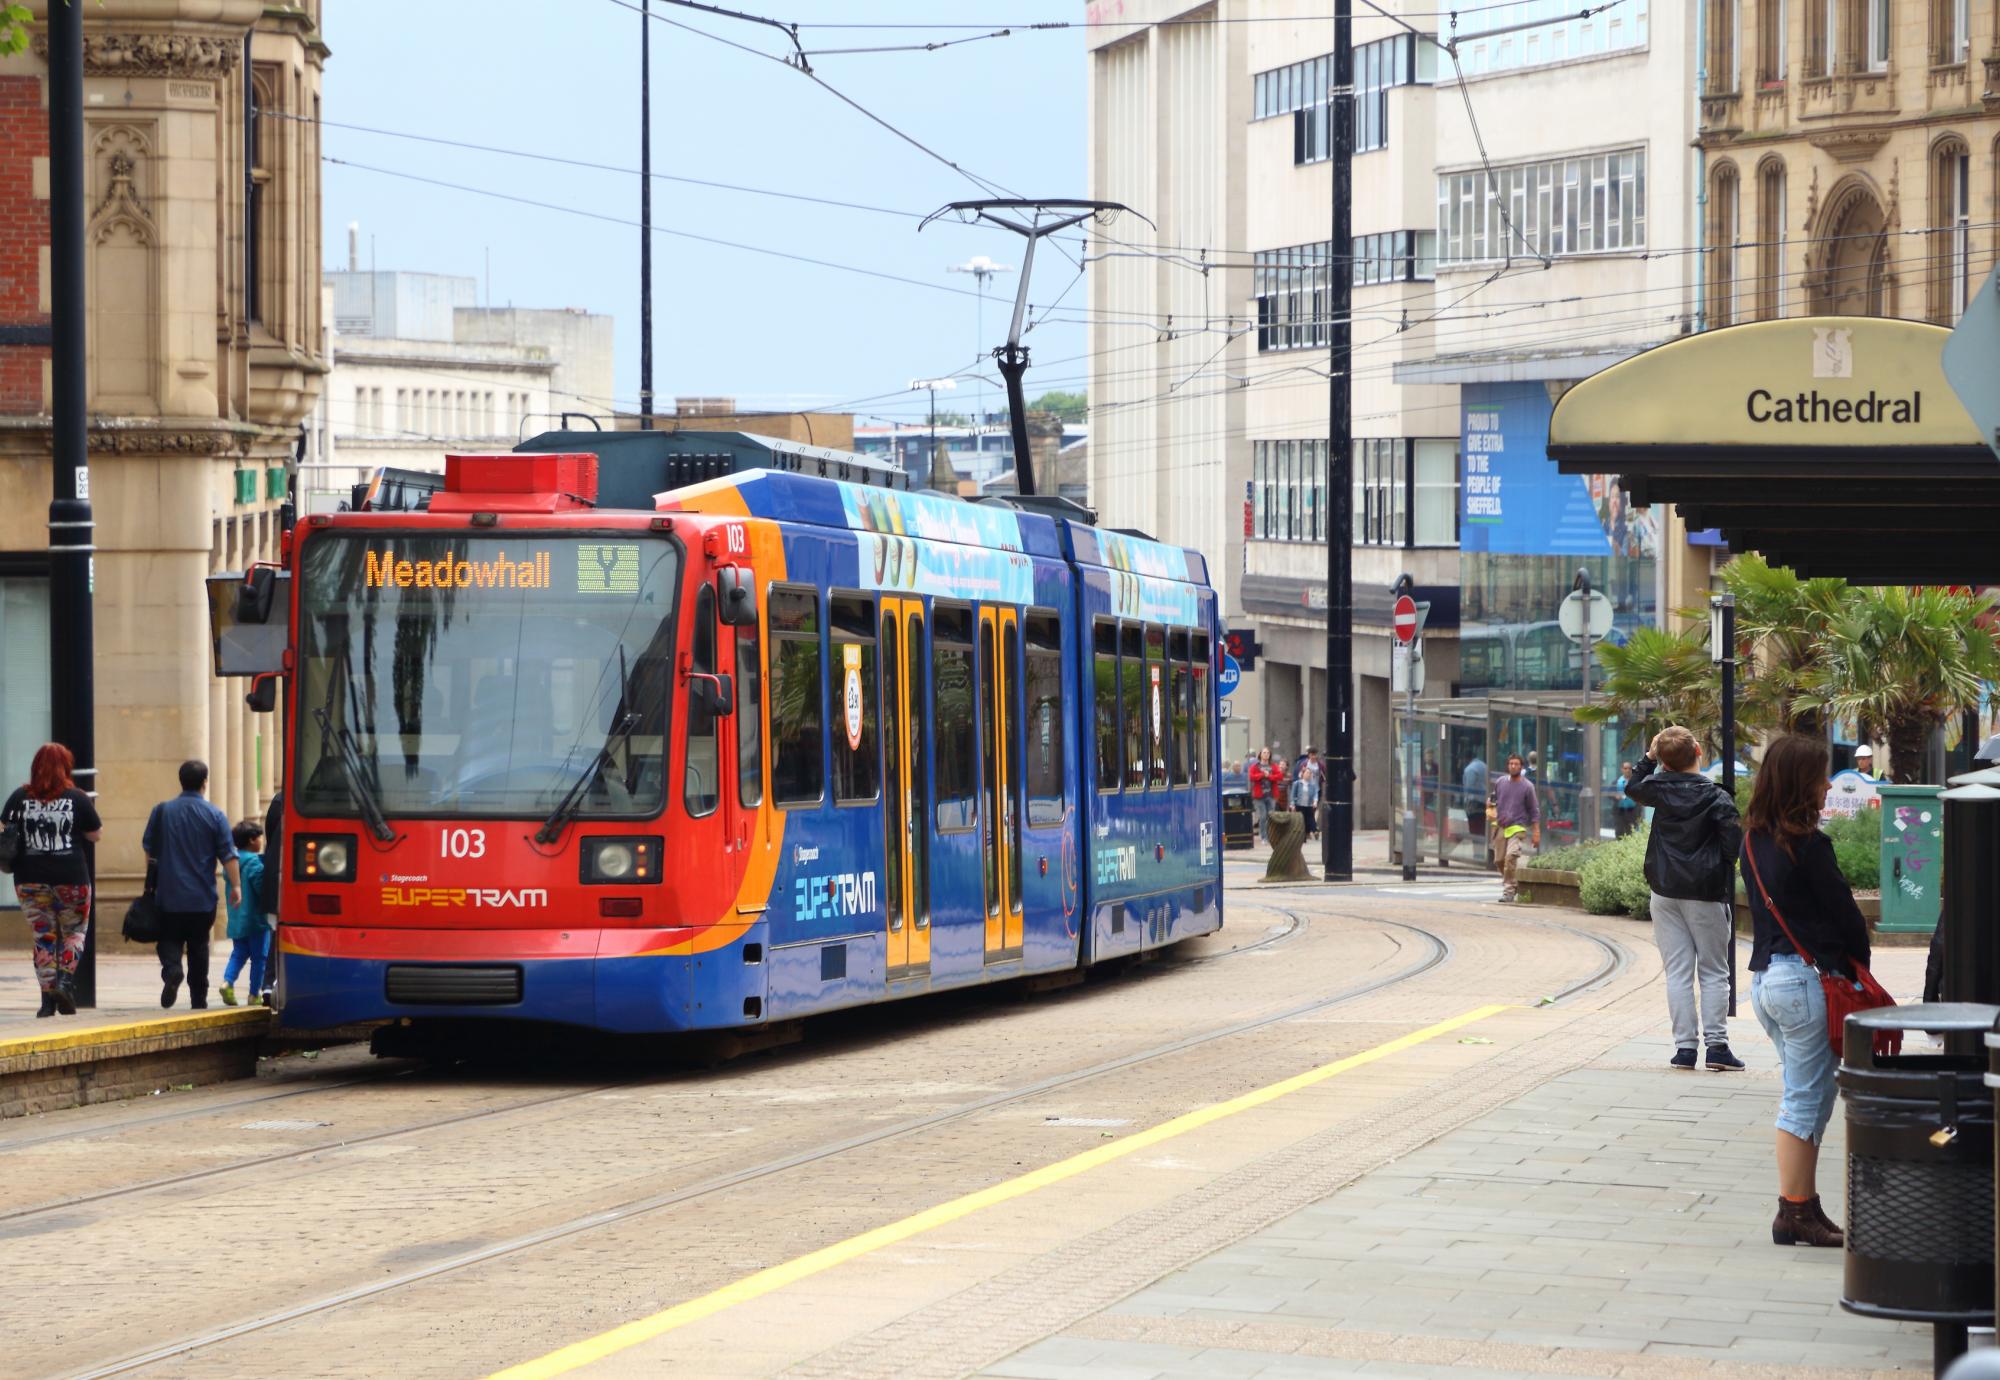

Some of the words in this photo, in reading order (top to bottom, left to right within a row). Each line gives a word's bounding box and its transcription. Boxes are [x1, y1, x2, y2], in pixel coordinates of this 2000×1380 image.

[1747, 389, 1921, 424] Cathedral
[1467, 413, 1489, 432] PROUD
[1490, 413, 1499, 432] TO
[1467, 434, 1482, 452] GIVE
[1483, 434, 1504, 452] EXTRA
[1467, 455, 1476, 473] TO
[1477, 455, 1489, 473] THE
[1467, 476, 1491, 494] PEOPLE
[1492, 476, 1501, 494] OF
[726, 524, 745, 553] 103
[366, 551, 550, 588] Meadowhall
[441, 829, 486, 858] 103
[1097, 845, 1136, 885] SUPERTRAM
[391, 875, 428, 883] Stagecoach
[381, 887, 548, 907] SUPERTRAM
[796, 871, 876, 921] SUPERTRAM
